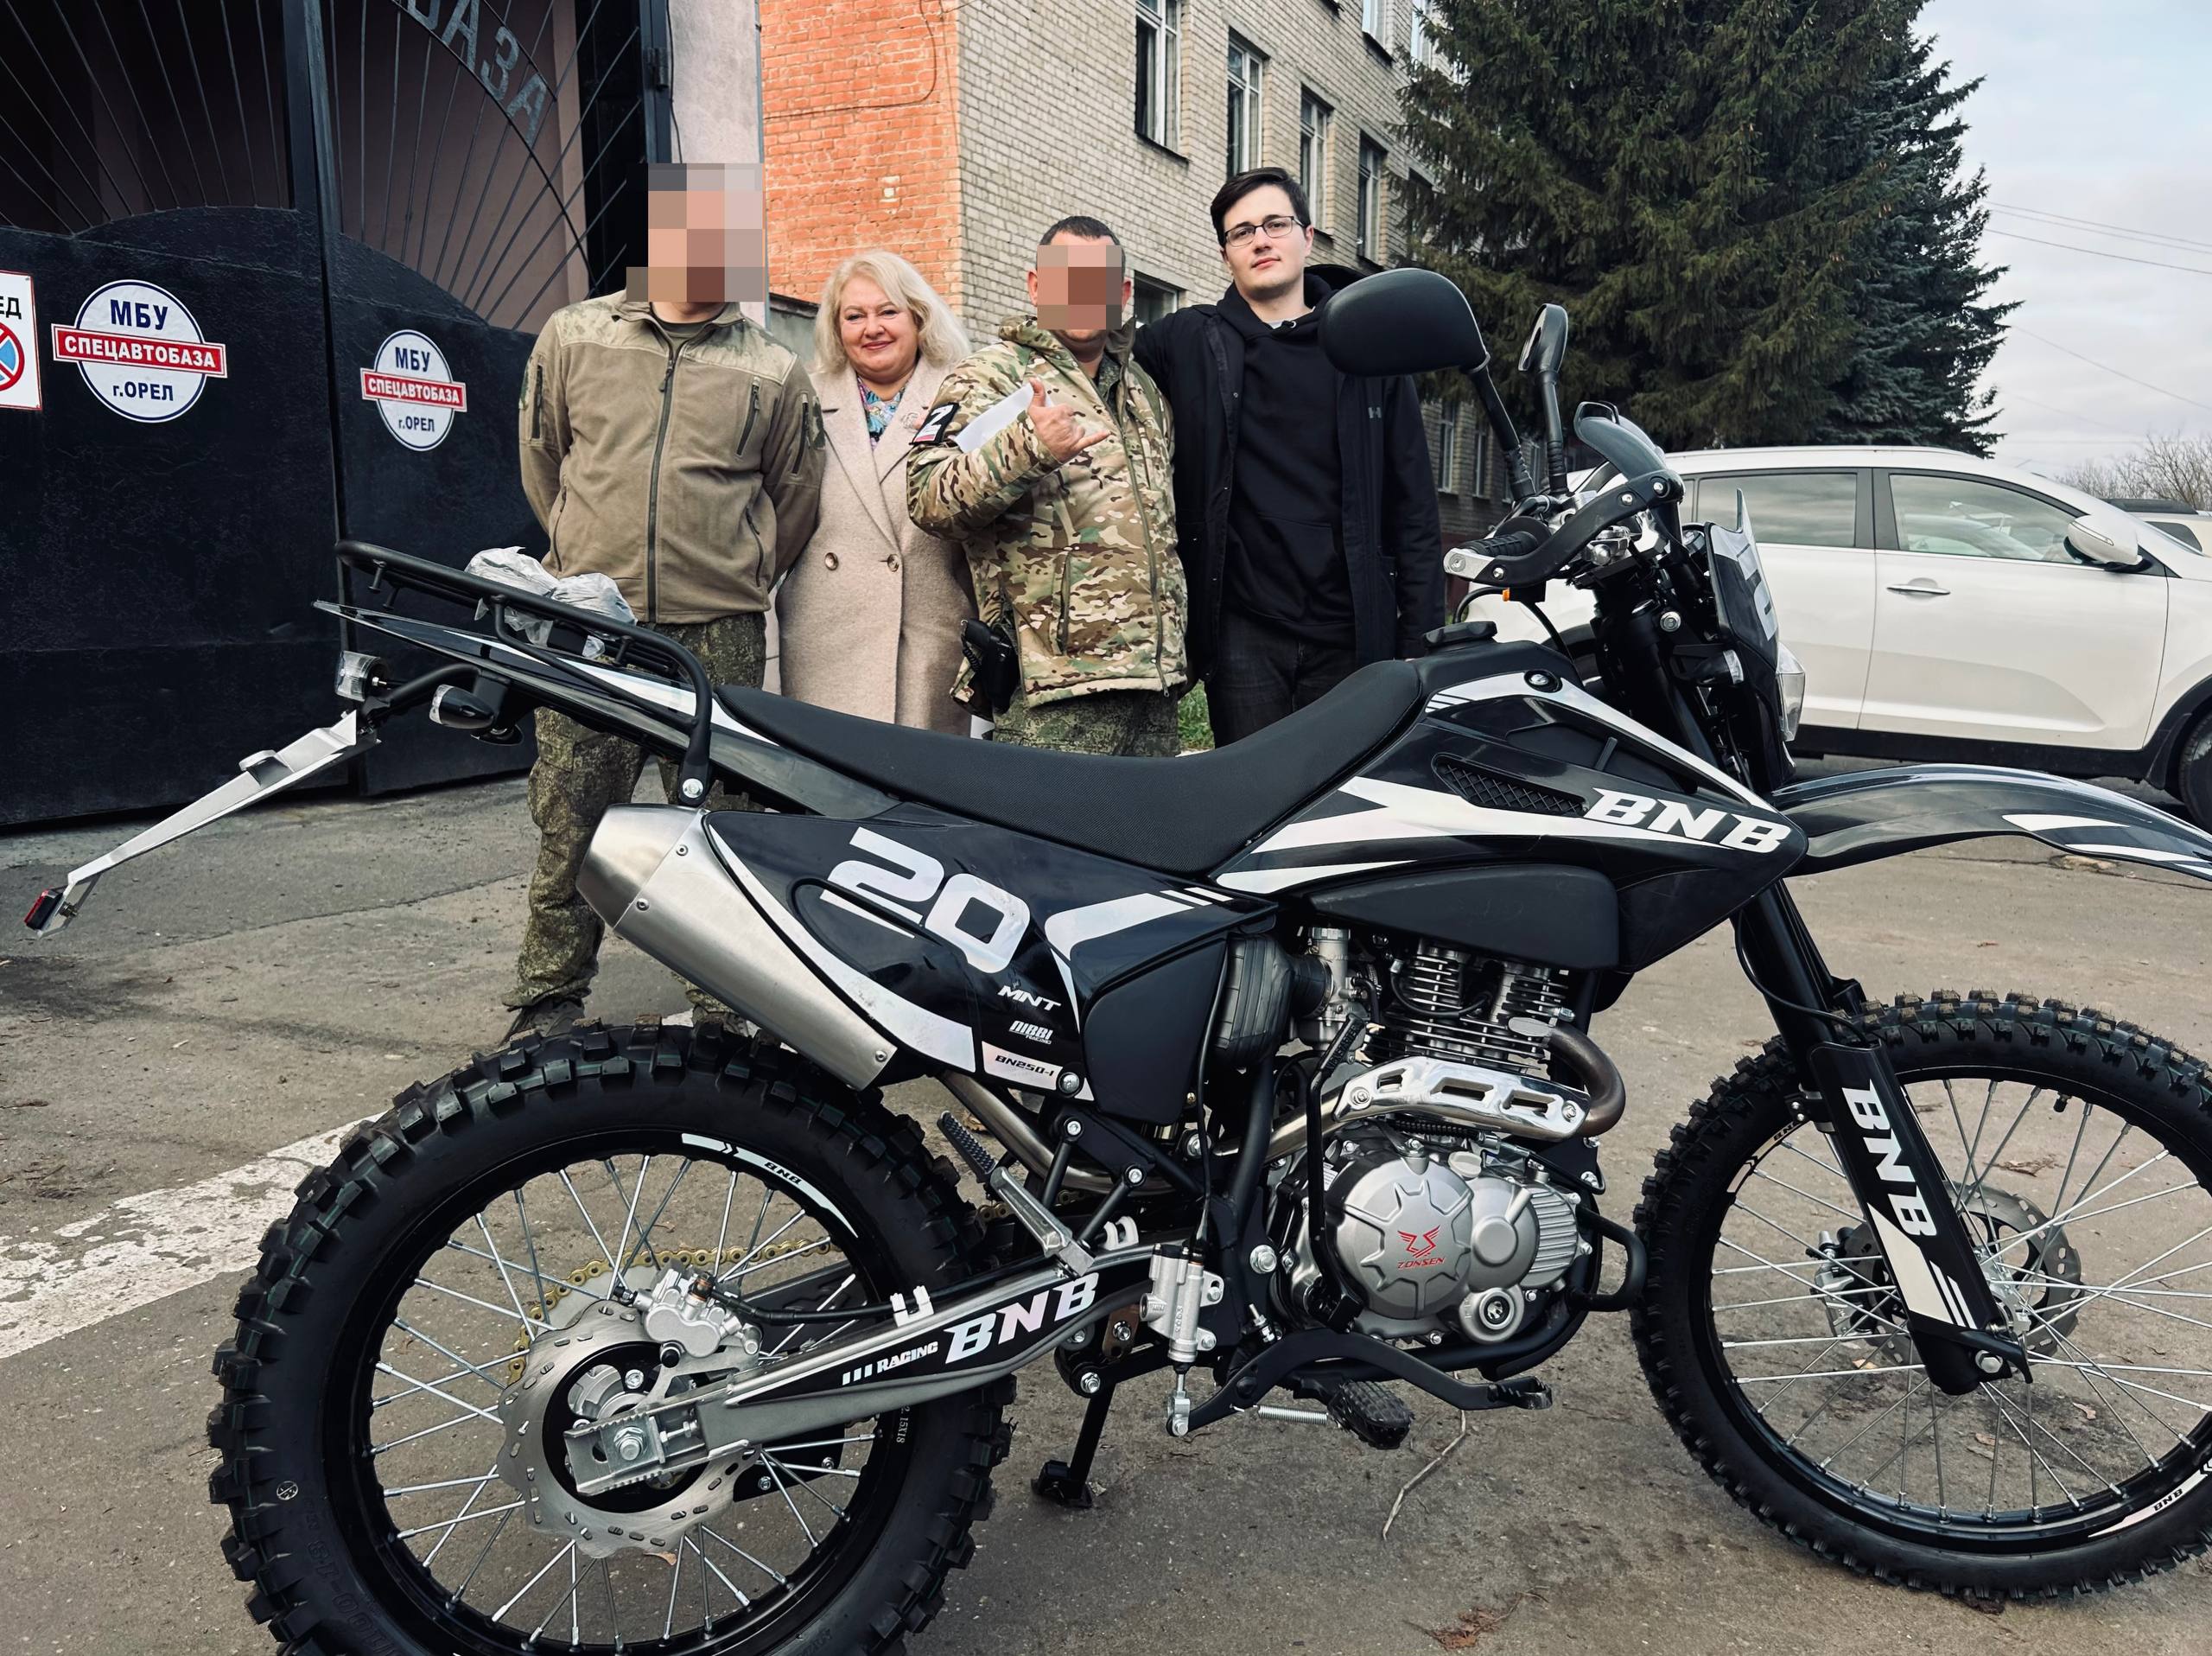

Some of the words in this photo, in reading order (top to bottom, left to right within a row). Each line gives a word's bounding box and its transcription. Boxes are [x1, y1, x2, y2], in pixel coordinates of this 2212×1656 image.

[110, 299, 168, 330] МБУ
[64, 335, 216, 368] СПЕЦАВТОБАЗА
[395, 347, 430, 373] МБУ
[112, 381, 174, 402] г.ОРЕЛ
[368, 378, 460, 404] СПЕЦАВТОБАЗА
[398, 416, 435, 432] г.ОРЕЛ
[1583, 787, 1791, 853] BNB
[819, 826, 1031, 973] 20
[997, 985, 1062, 1011] MNT
[1773, 1123, 1796, 1141] BN
[1841, 1079, 1937, 1237] BNB
[764, 1162, 802, 1185] BNB
[876, 1341, 938, 1374] RACING
[943, 1272, 1099, 1365] BNB
[2152, 1488, 2183, 1512] BNB
